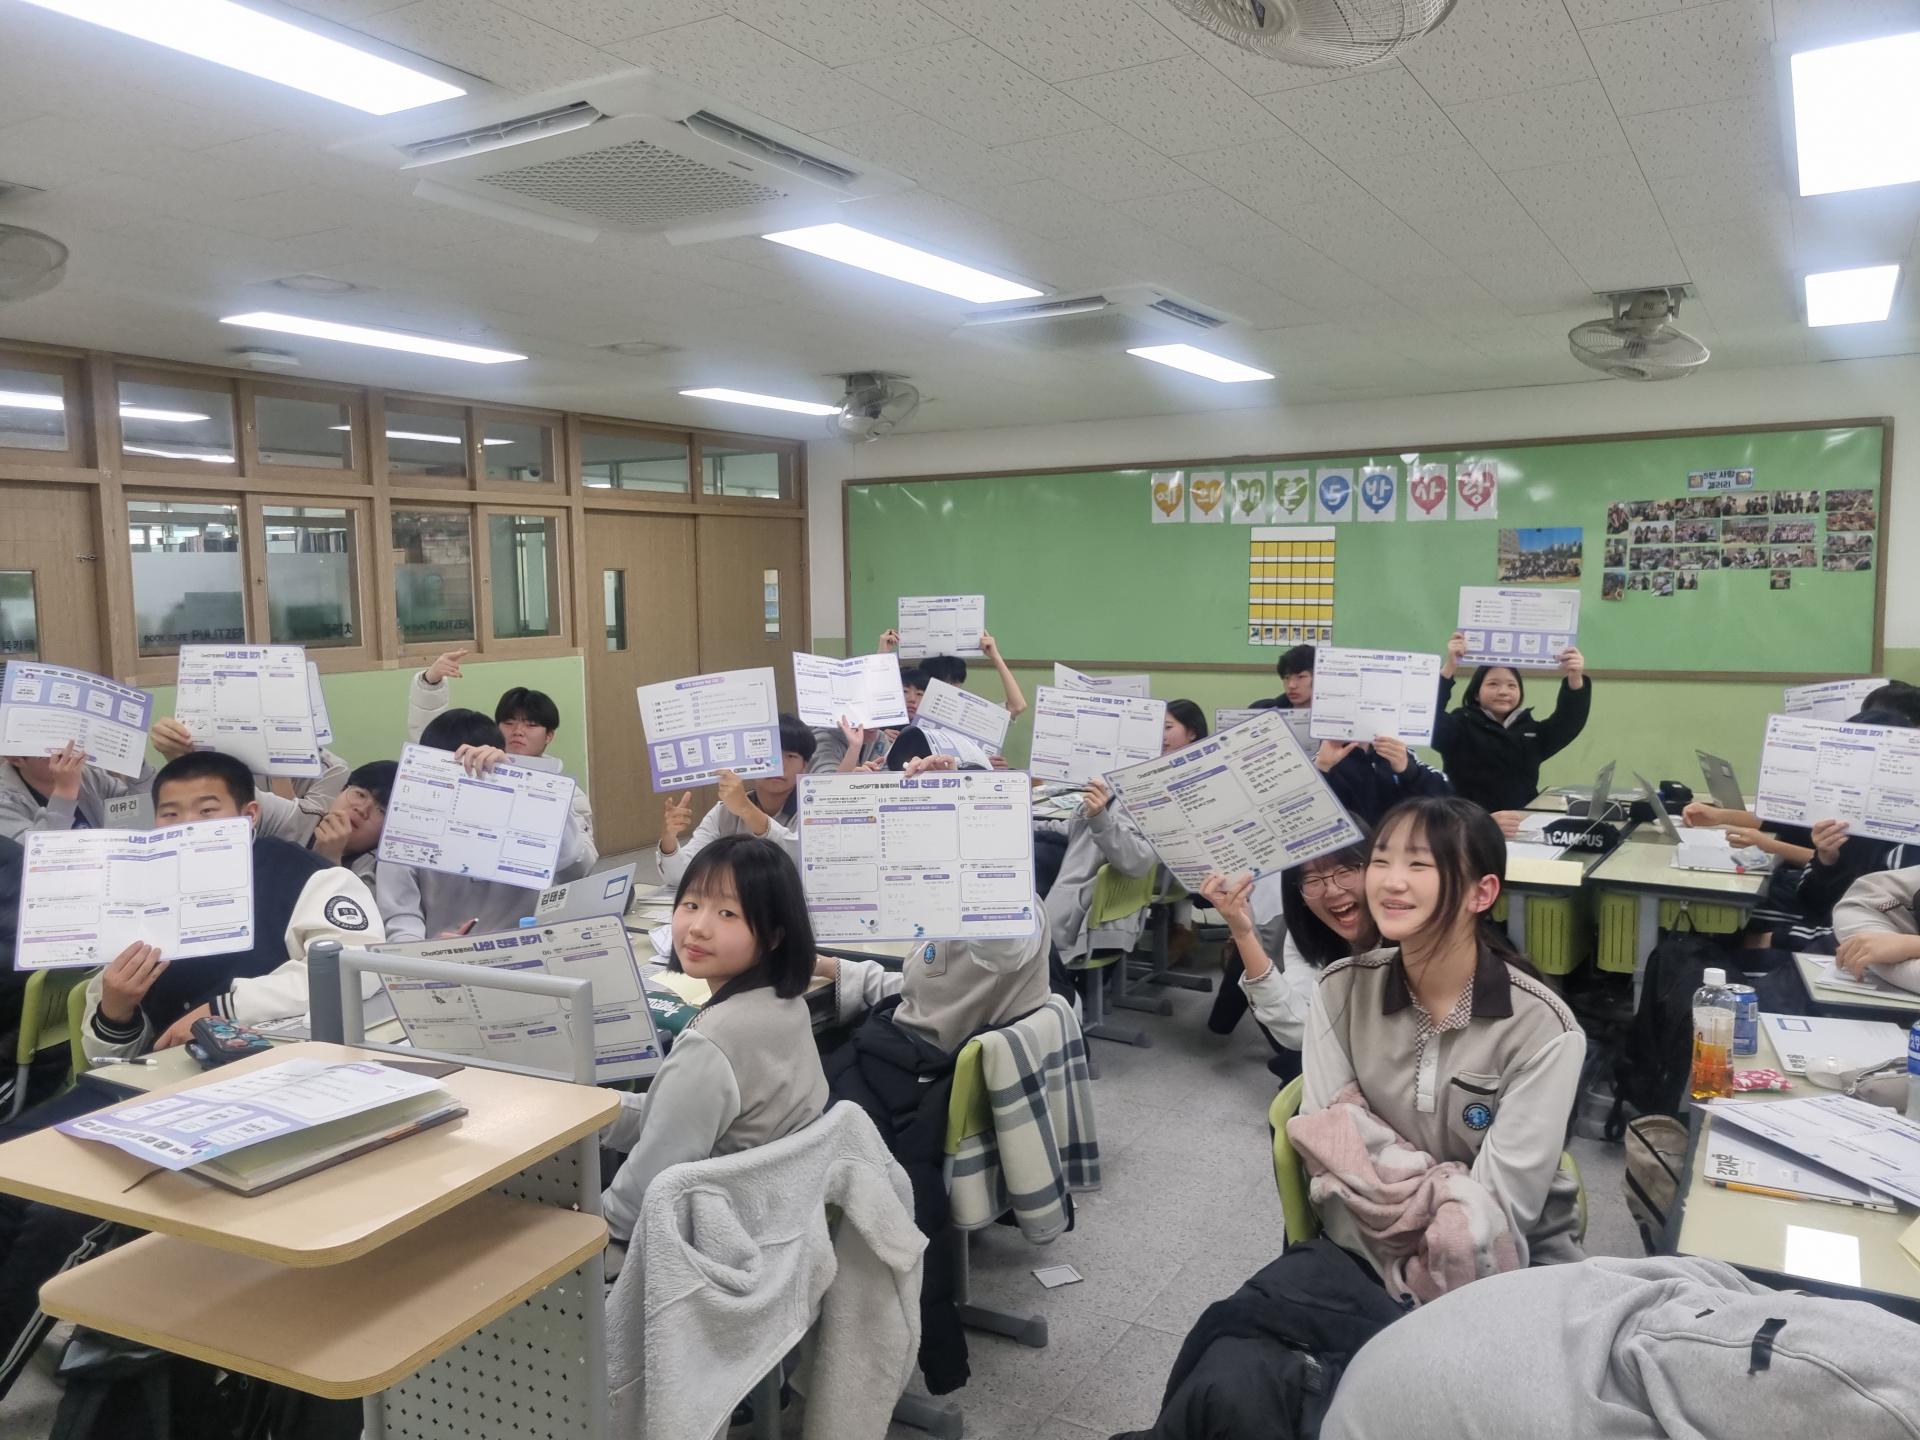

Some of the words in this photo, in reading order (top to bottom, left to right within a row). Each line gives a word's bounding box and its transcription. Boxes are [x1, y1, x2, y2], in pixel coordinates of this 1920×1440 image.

[900, 779, 919, 789] 나의
[921, 779, 940, 789] 진로
[942, 778, 961, 789] 찾기
[1552, 830, 1604, 847] CAMPUS
[473, 940, 496, 952] 나의
[496, 937, 519, 948] 진로
[519, 934, 543, 946] 찾기
